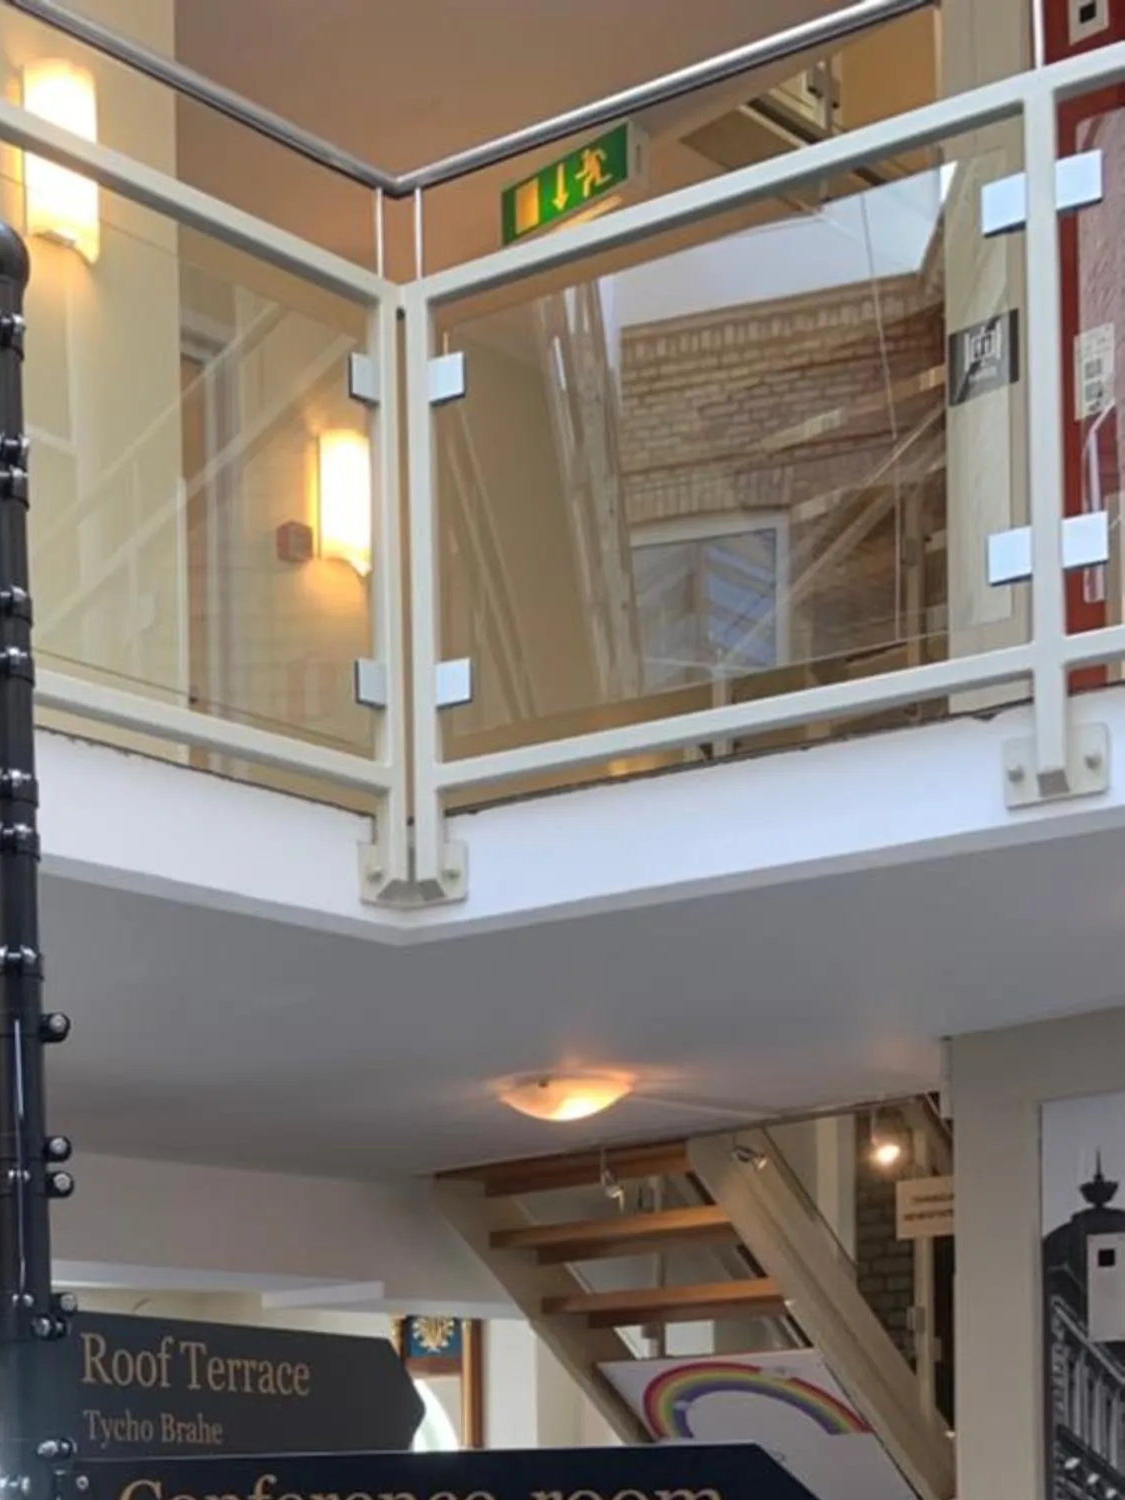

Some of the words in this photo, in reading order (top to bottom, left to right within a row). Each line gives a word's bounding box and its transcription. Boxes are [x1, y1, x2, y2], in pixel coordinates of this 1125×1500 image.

[80, 1333, 174, 1389] Roof
[180, 1340, 310, 1396] Terrace
[83, 1408, 154, 1448] Tycho
[159, 1412, 223, 1445] Brahe
